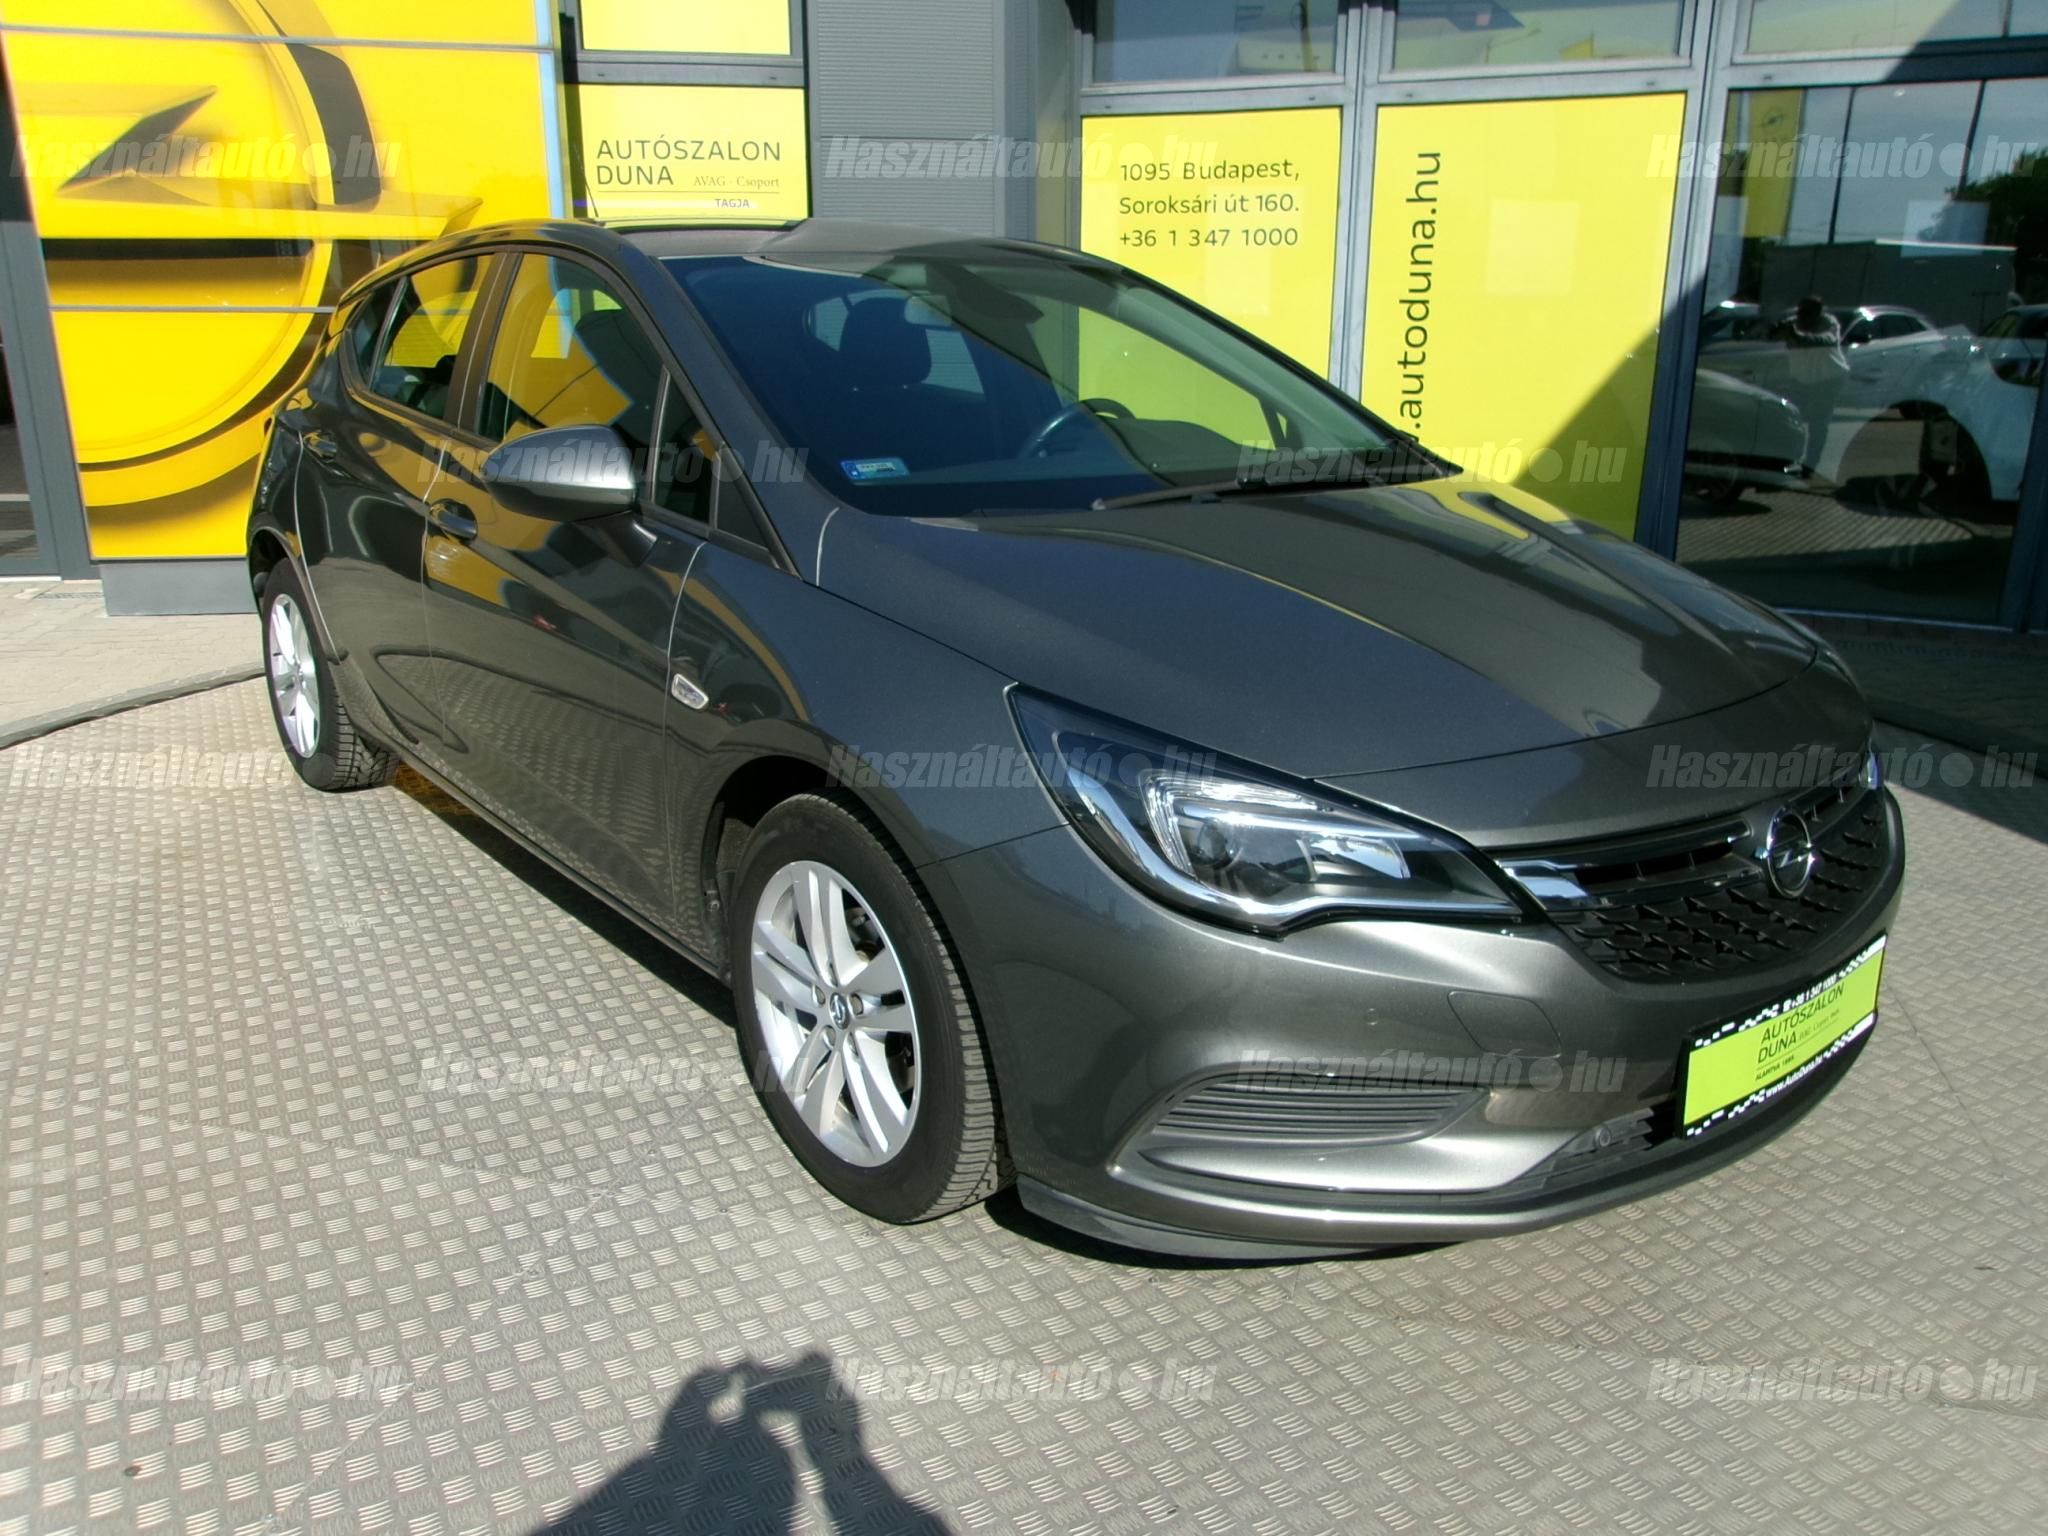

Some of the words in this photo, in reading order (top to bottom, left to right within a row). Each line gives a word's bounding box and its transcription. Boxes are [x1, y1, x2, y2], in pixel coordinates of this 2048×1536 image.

[597, 134, 781, 161] AUTÓSZALON
[597, 165, 674, 186] DUNA
[693, 175, 726, 187] AVAG
[736, 175, 780, 190] Csoport
[1121, 163, 1171, 181] 1095
[1182, 159, 1300, 183] Budapest,
[714, 198, 750, 208] TAGJA
[1119, 194, 1217, 215] Soroksári
[1224, 194, 1249, 213] út
[1255, 193, 1300, 213] 160.
[1119, 229, 1157, 247] +36
[1168, 229, 1178, 247] 1
[1188, 229, 1231, 247] 347
[1242, 227, 1299, 246] 1000
[1761, 981, 1845, 1044] AUTÓSZALON
[1758, 1031, 1797, 1064] DUNA
